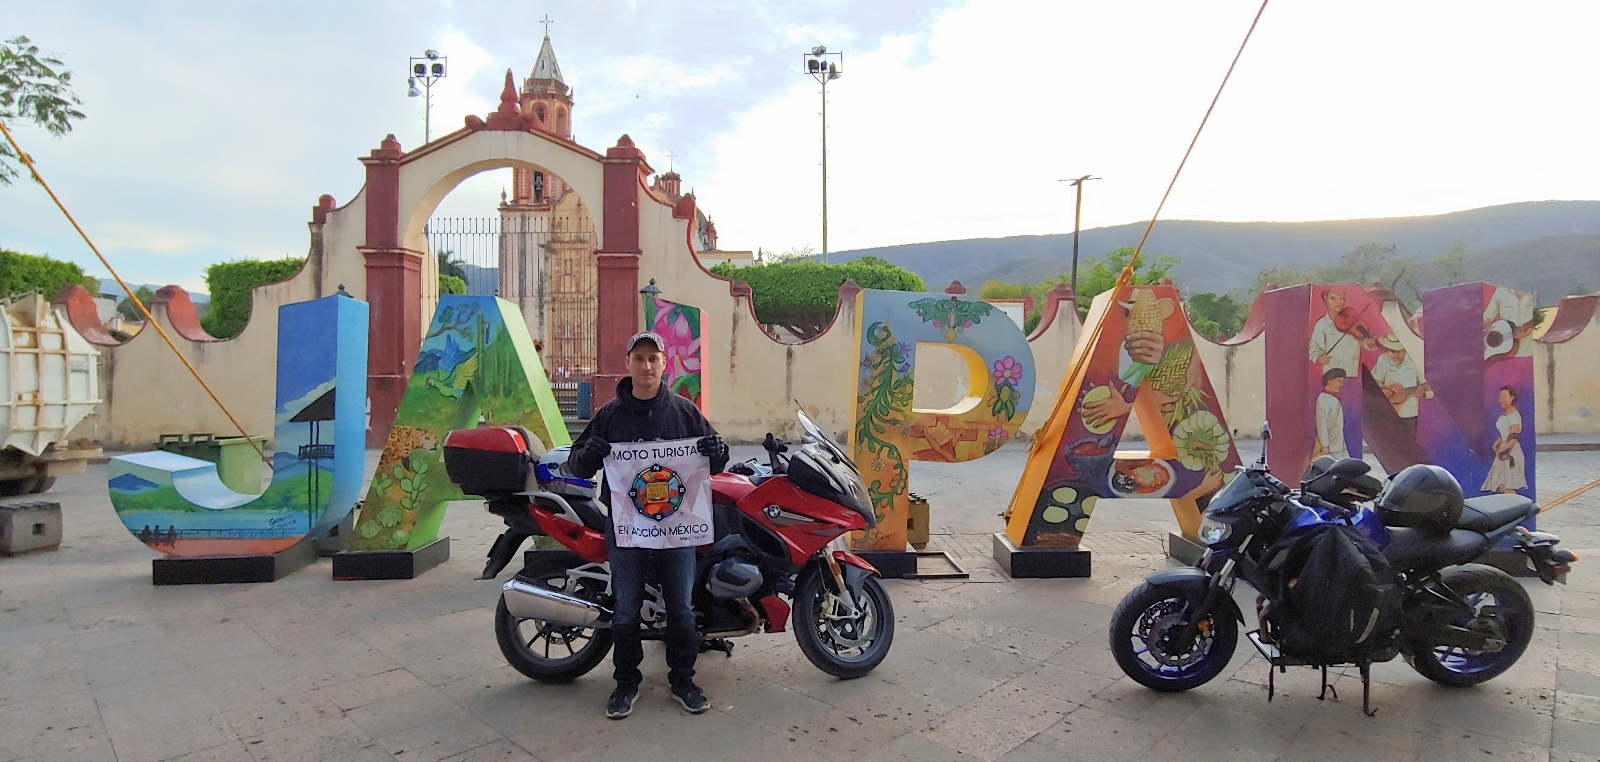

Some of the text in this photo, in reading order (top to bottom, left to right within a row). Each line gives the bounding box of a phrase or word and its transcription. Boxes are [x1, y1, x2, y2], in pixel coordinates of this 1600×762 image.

[612, 445, 698, 461] MOTO TURISTA
[618, 525, 629, 535] EN
[631, 525, 667, 538] ACCIÓN
[668, 523, 709, 536] MÉXICO
